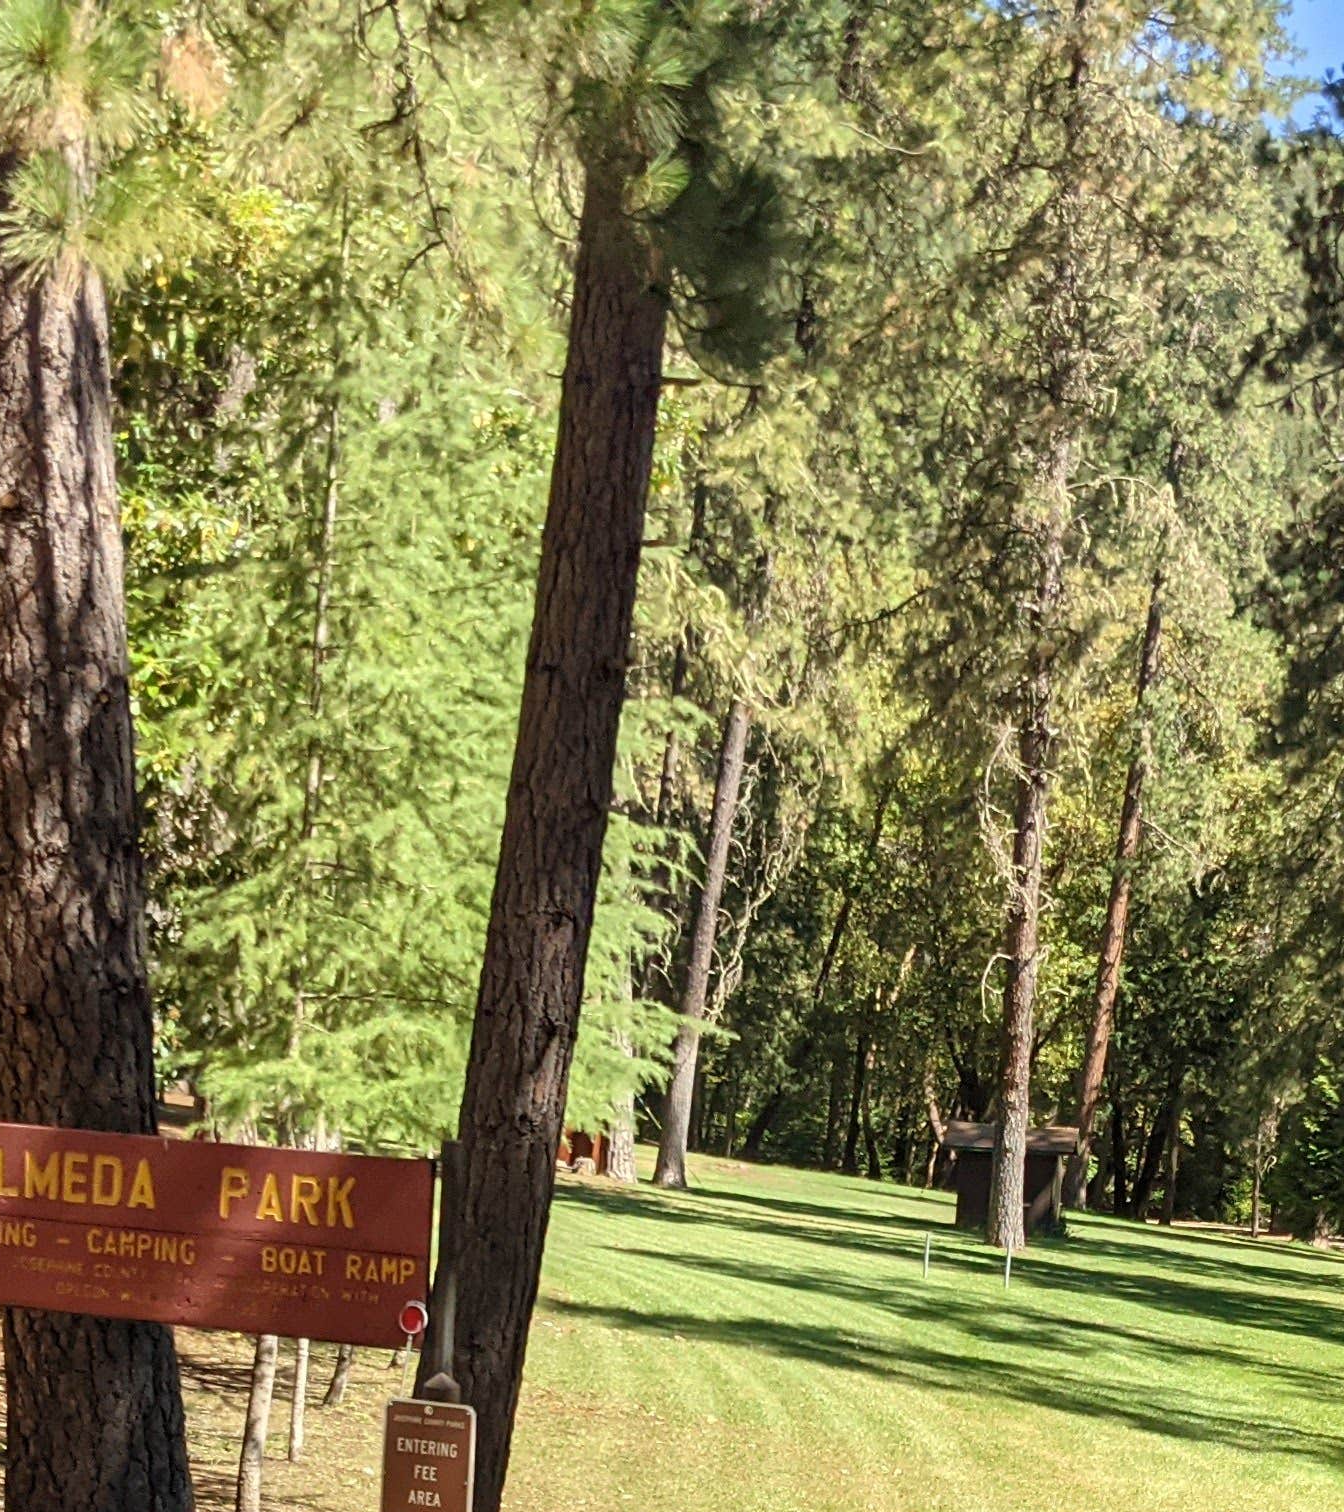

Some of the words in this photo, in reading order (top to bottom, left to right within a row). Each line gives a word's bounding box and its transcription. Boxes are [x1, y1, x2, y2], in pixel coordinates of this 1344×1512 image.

[219, 1166, 356, 1229] PARK
[87, 1227, 197, 1266] CAMPING
[260, 1246, 327, 1277] BOAT
[345, 1254, 417, 1286] RAMP
[396, 1436, 458, 1459] ENTERING
[413, 1464, 439, 1482] FEE
[407, 1489, 442, 1508] AREA
